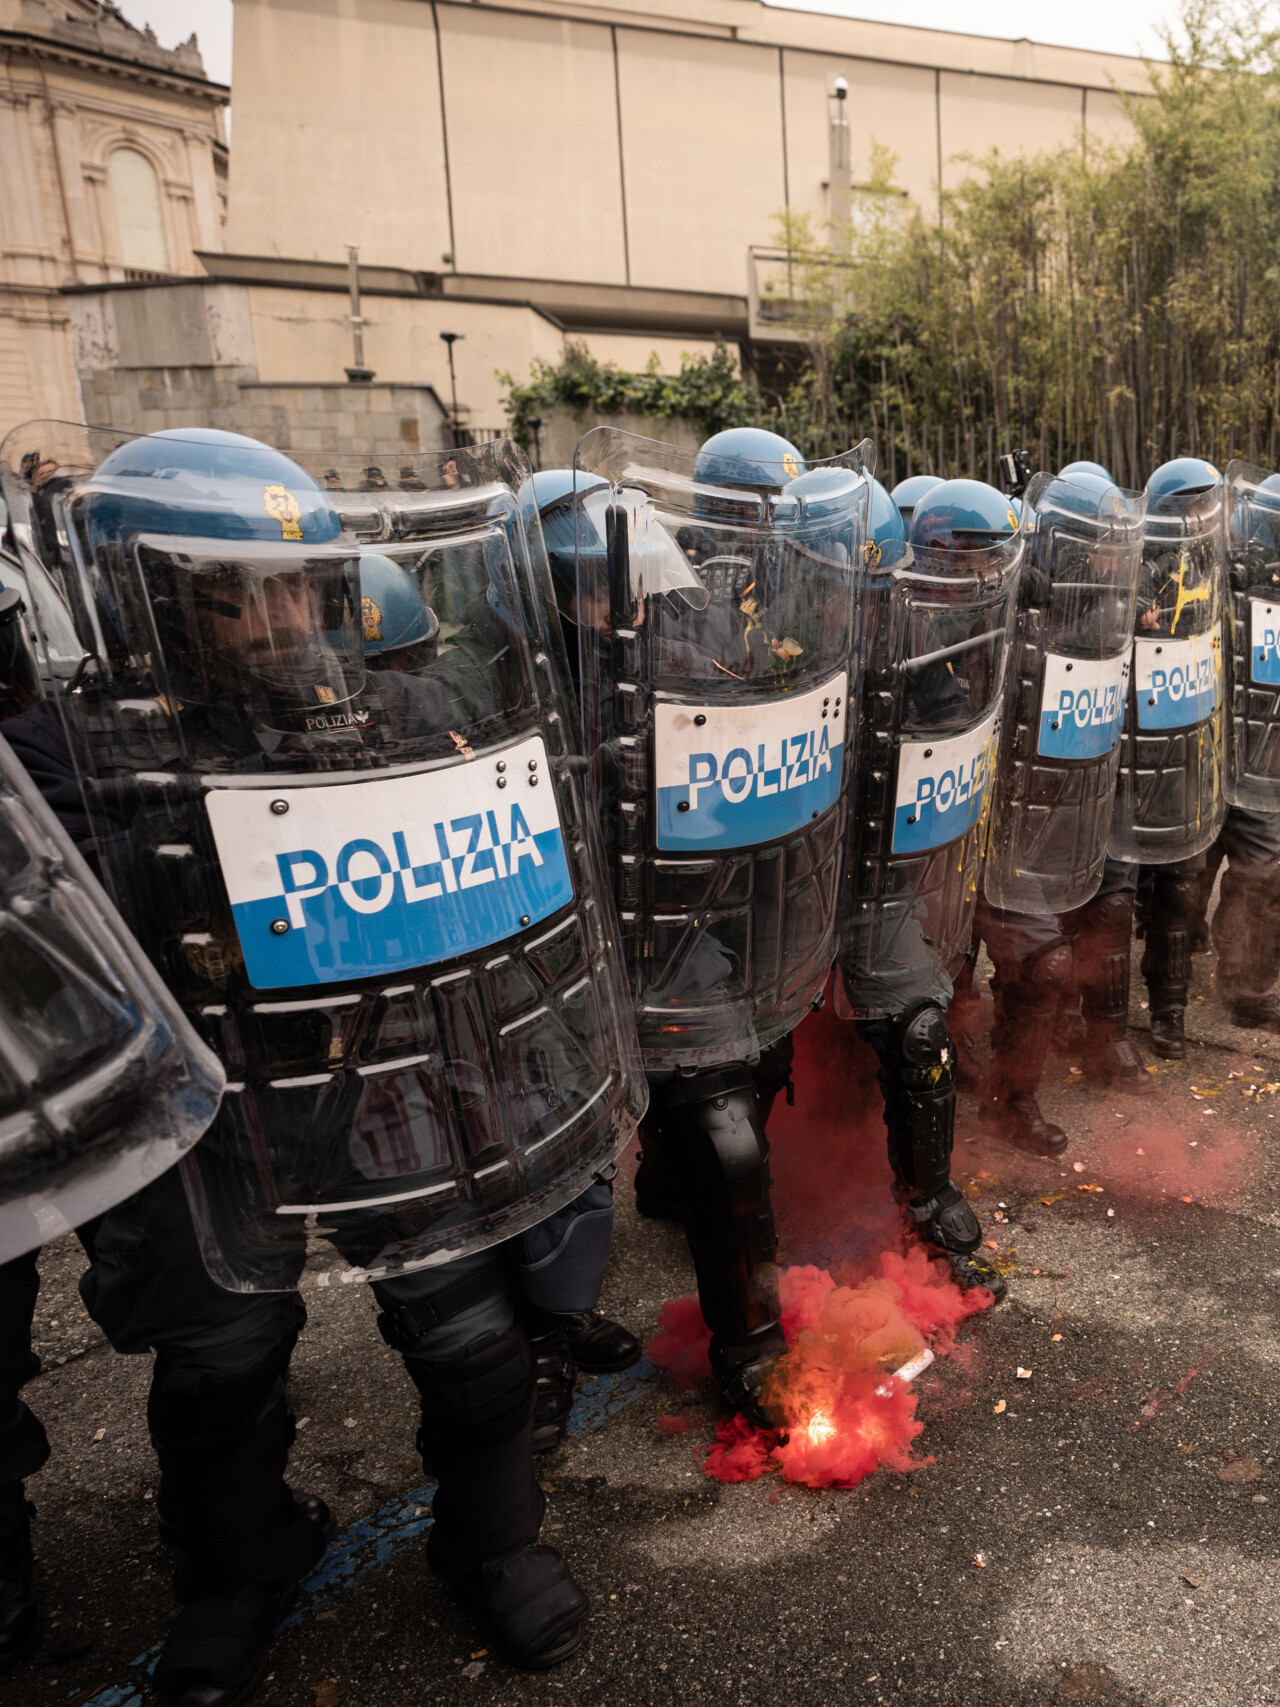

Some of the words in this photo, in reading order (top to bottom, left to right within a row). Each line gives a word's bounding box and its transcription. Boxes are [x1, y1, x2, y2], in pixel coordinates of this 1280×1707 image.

[306, 712, 358, 731] POLIZIA
[685, 724, 832, 811] POLIZIA
[276, 802, 544, 930] POLIZIA
